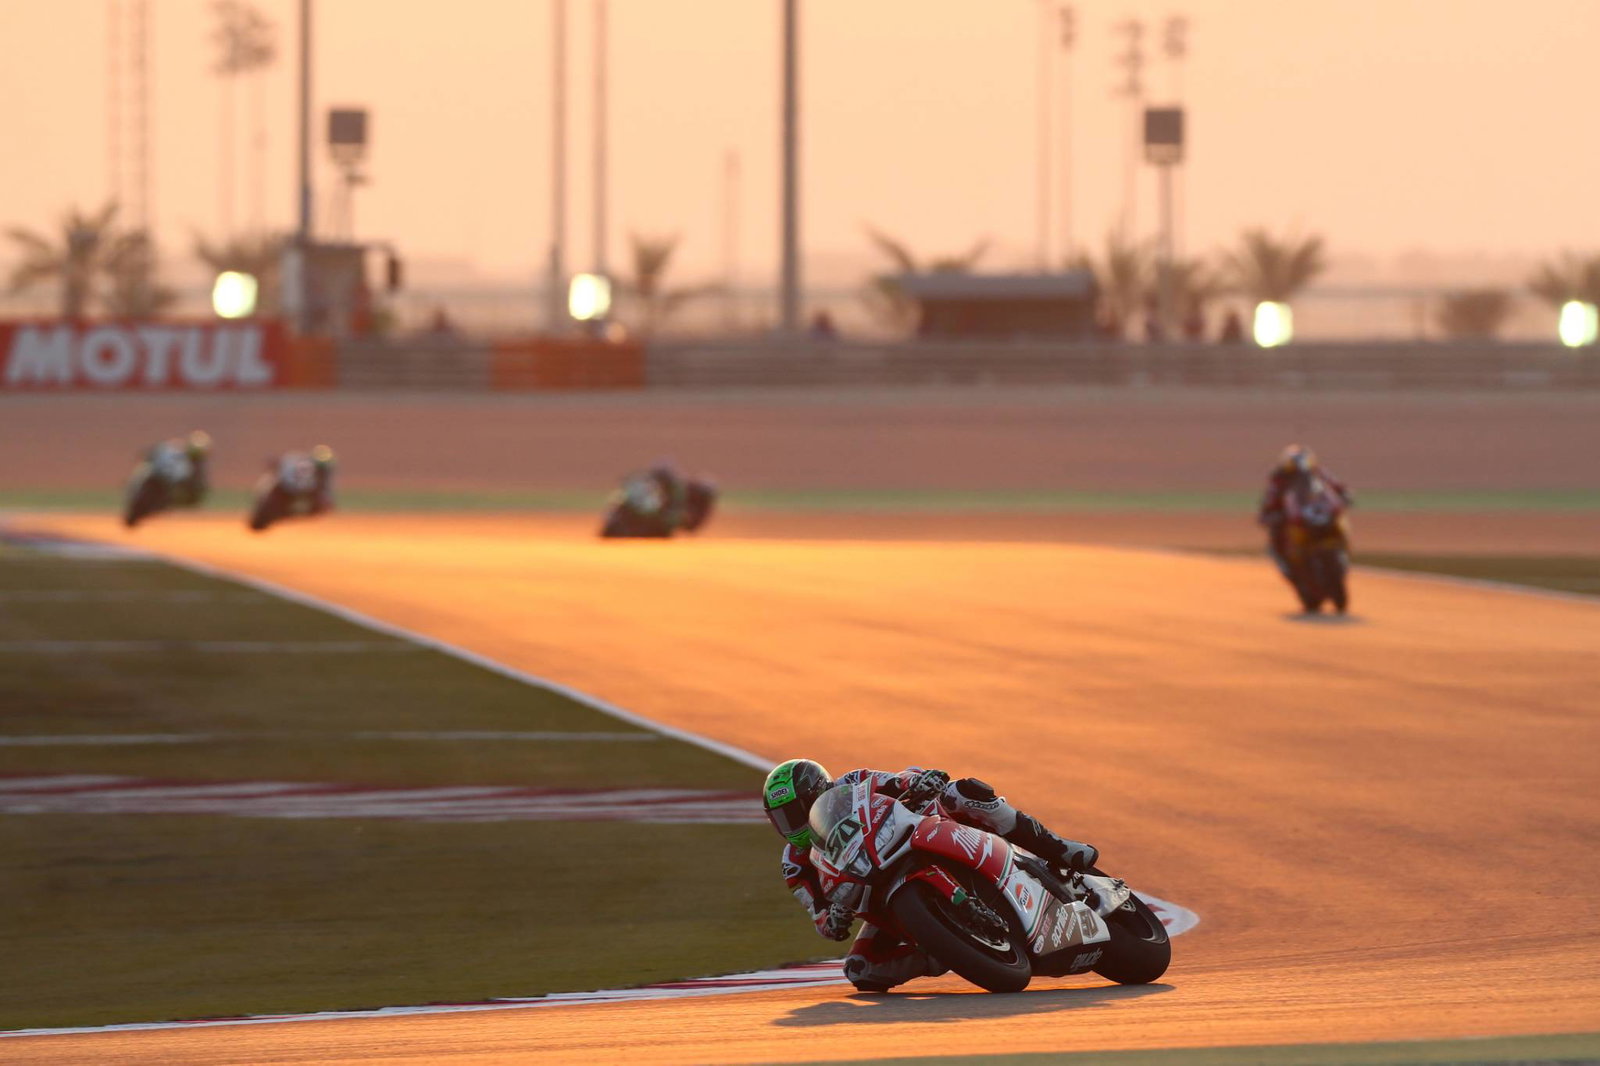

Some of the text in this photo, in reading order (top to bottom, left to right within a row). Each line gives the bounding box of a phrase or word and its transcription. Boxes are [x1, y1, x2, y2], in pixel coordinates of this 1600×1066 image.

[7, 324, 274, 385] MOTUL
[770, 787, 788, 799] SHOEI
[1052, 906, 1068, 948] aprilia
